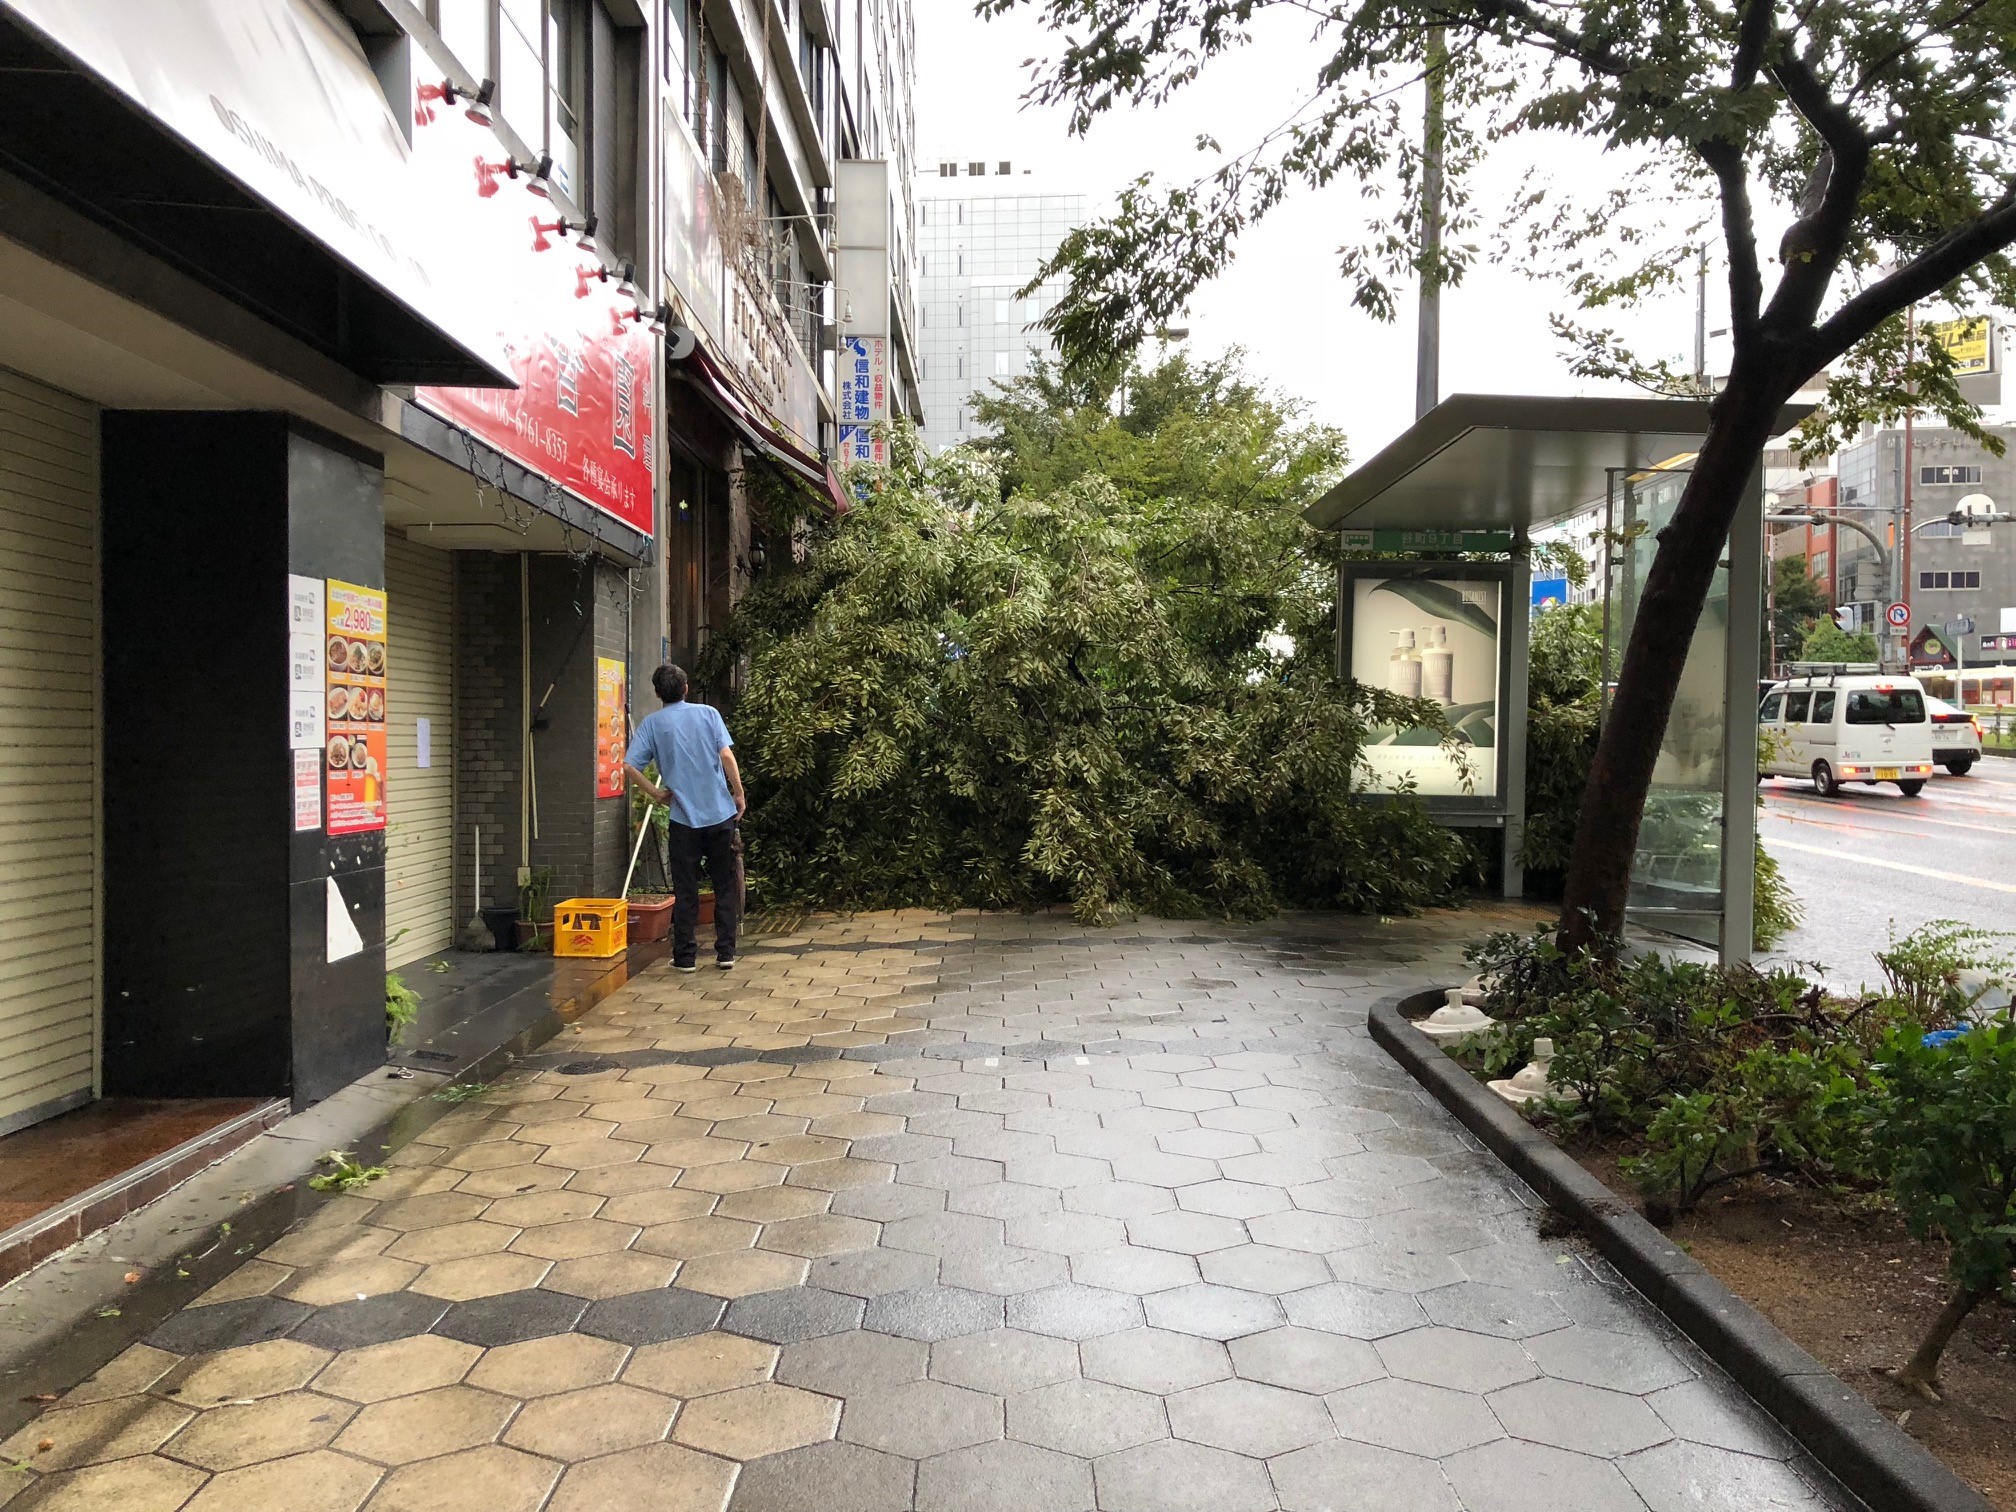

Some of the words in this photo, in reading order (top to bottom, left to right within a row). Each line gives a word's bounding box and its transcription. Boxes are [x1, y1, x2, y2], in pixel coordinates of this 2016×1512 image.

[854, 358, 870, 420] 信和建物
[874, 340, 883, 410] ホテル・収益物件
[842, 381, 852, 420] 株式会社
[581, 453, 637, 512] 各種宴会承ります
[1402, 532, 1463, 545] 谷町9丁目
[344, 606, 371, 631] 2,980
